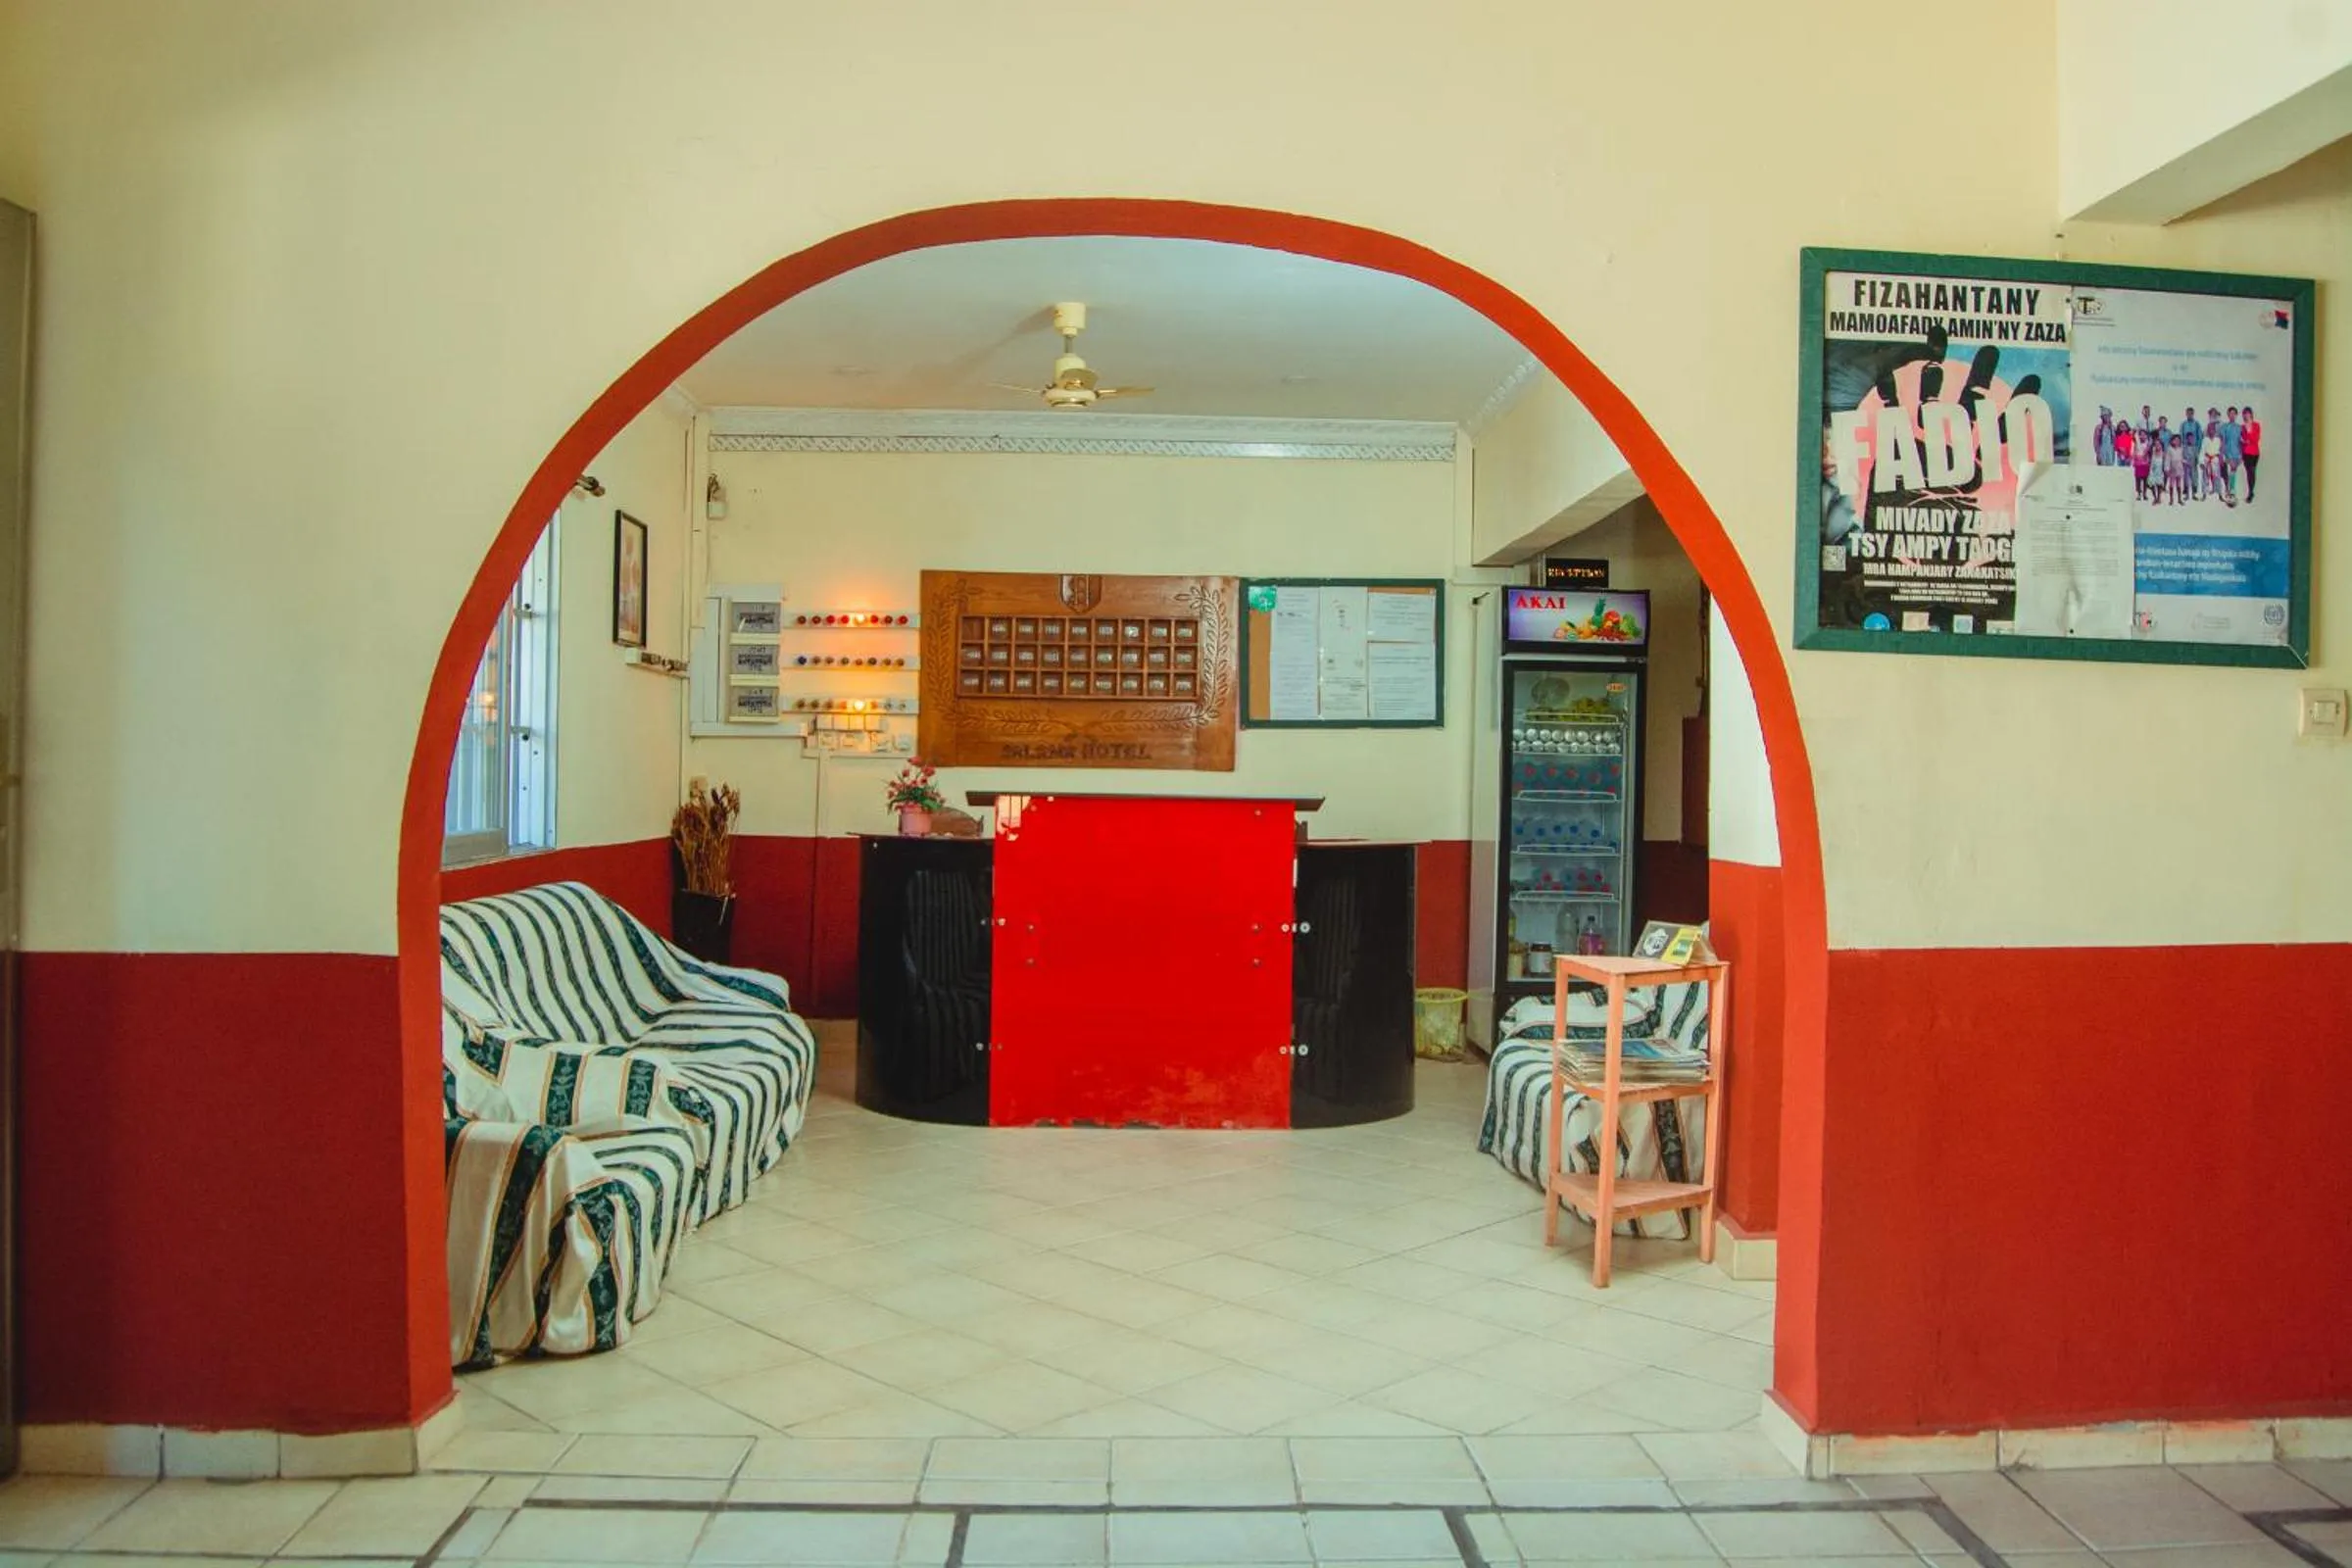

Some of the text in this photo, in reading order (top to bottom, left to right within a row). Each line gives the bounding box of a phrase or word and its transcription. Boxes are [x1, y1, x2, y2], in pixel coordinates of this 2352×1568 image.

[1854, 279, 2040, 316] FIZAHANTANY
[1948, 318, 2021, 340] AMIN'NY
[2025, 321, 2067, 343] ZAZA
[1876, 506, 1958, 533] MIVADY
[1849, 533, 1888, 558] TSY
[1892, 535, 1952, 561] AMPY
[1956, 536, 2014, 563] TAOG
[1516, 595, 1565, 609] AKAI
[1081, 742, 1152, 760] HOTEL
